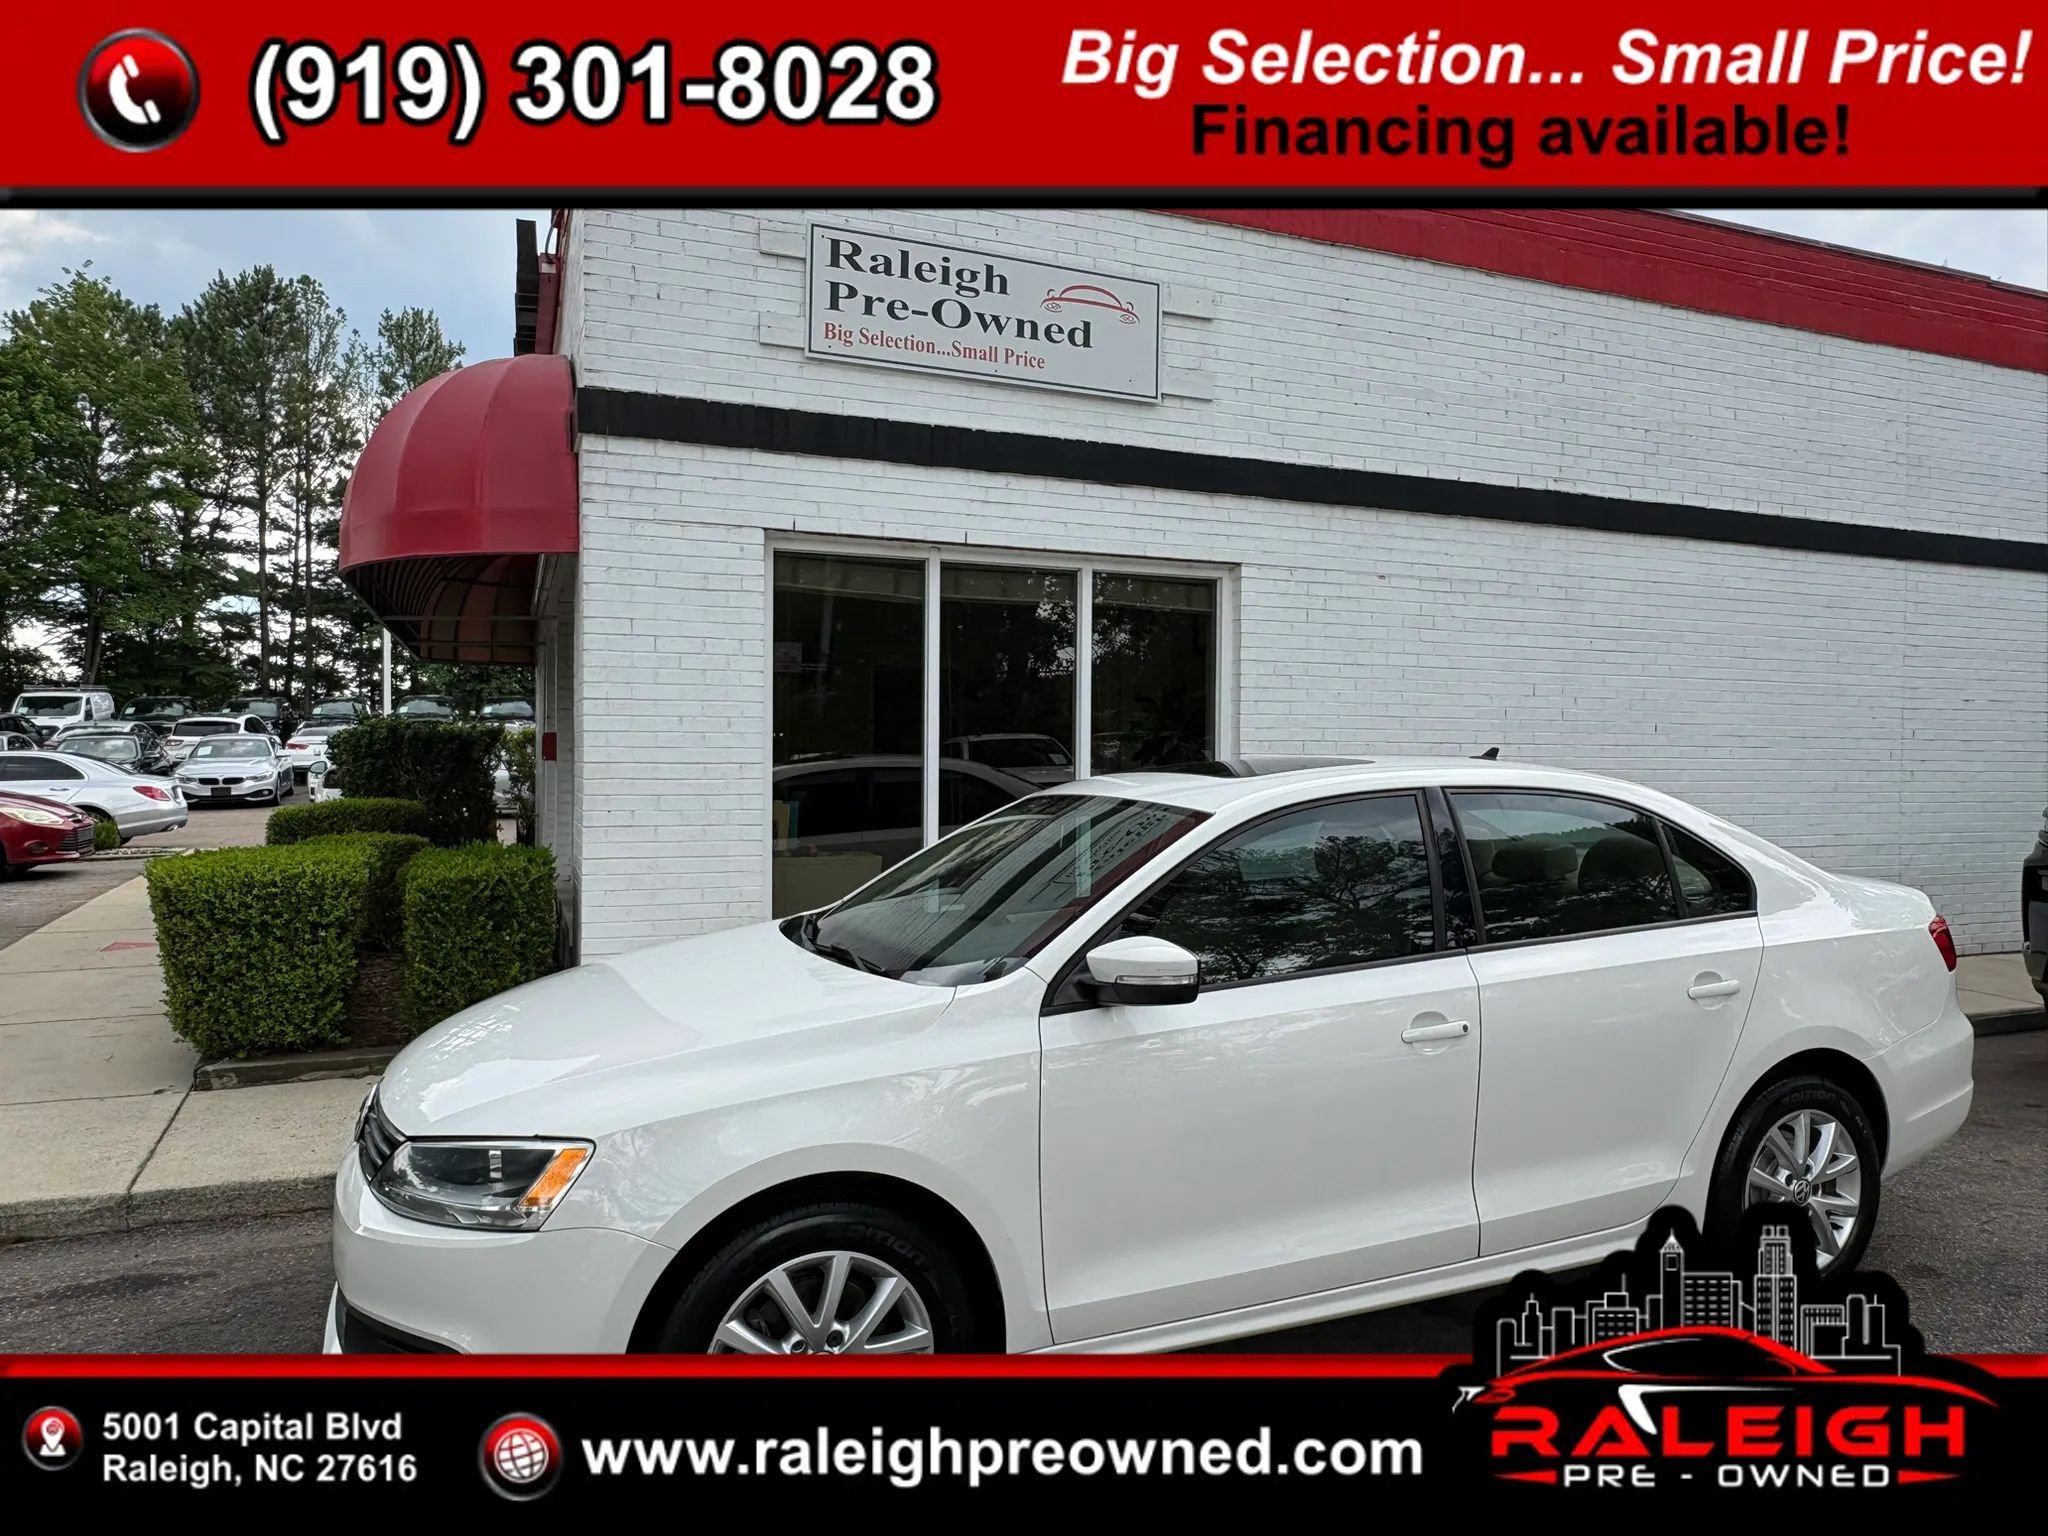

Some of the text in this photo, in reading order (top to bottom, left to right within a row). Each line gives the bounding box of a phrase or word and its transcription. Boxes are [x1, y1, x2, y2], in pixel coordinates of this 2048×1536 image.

[825, 237, 1010, 299] Raleigh
[824, 279, 1094, 349] Pre-Owned
[823, 321, 854, 348] Big
[1003, 350, 1046, 370] Price
